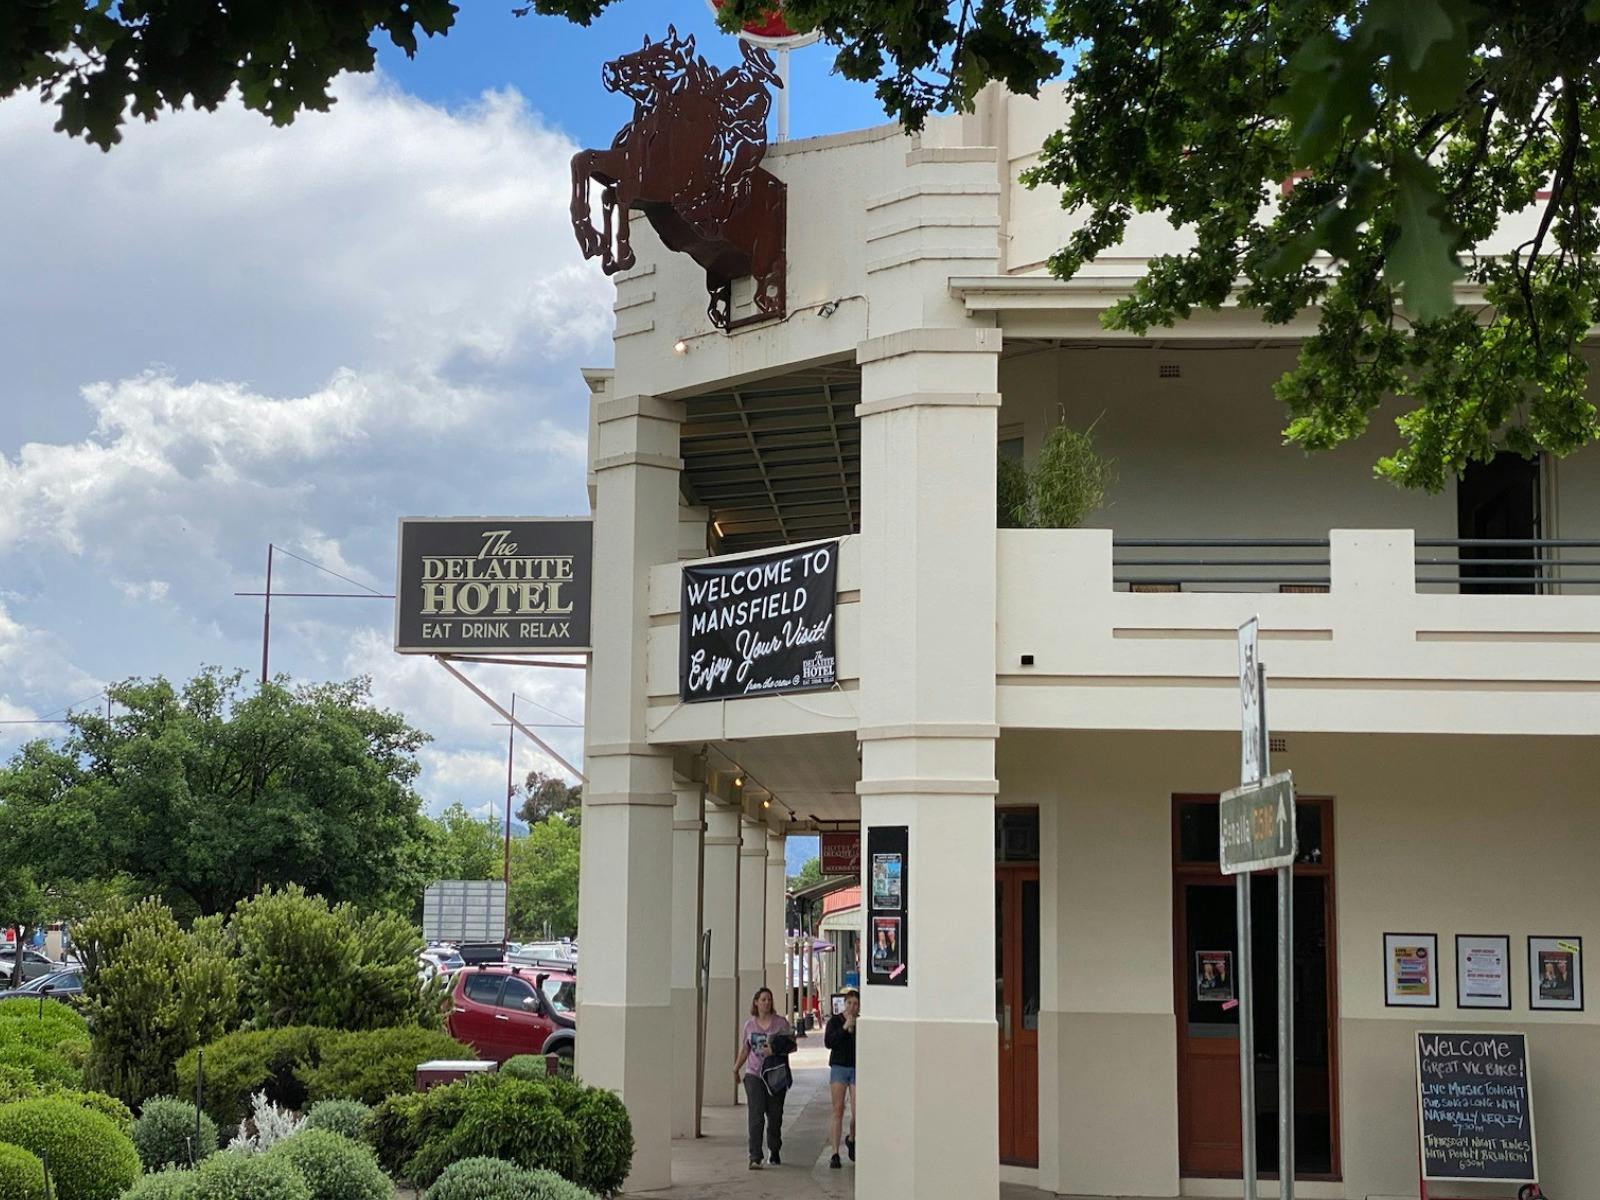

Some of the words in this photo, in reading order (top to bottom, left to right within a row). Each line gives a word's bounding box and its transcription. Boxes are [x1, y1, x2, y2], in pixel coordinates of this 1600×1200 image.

[477, 530, 518, 560] The
[422, 558, 574, 580] DELATITE
[688, 558, 794, 606] WELCOME
[801, 549, 830, 577] TO
[420, 582, 574, 615] HOTEL
[691, 587, 807, 637] MANSFIELD
[422, 623, 452, 639] EAT
[462, 622, 510, 639] DRINK
[520, 622, 570, 639] RELAX
[688, 649, 732, 691] Enjoy
[735, 629, 782, 683] Your
[782, 612, 832, 648] Visit!
[803, 665, 835, 678] HOTEL
[1448, 1081, 1483, 1097] MUSIC
